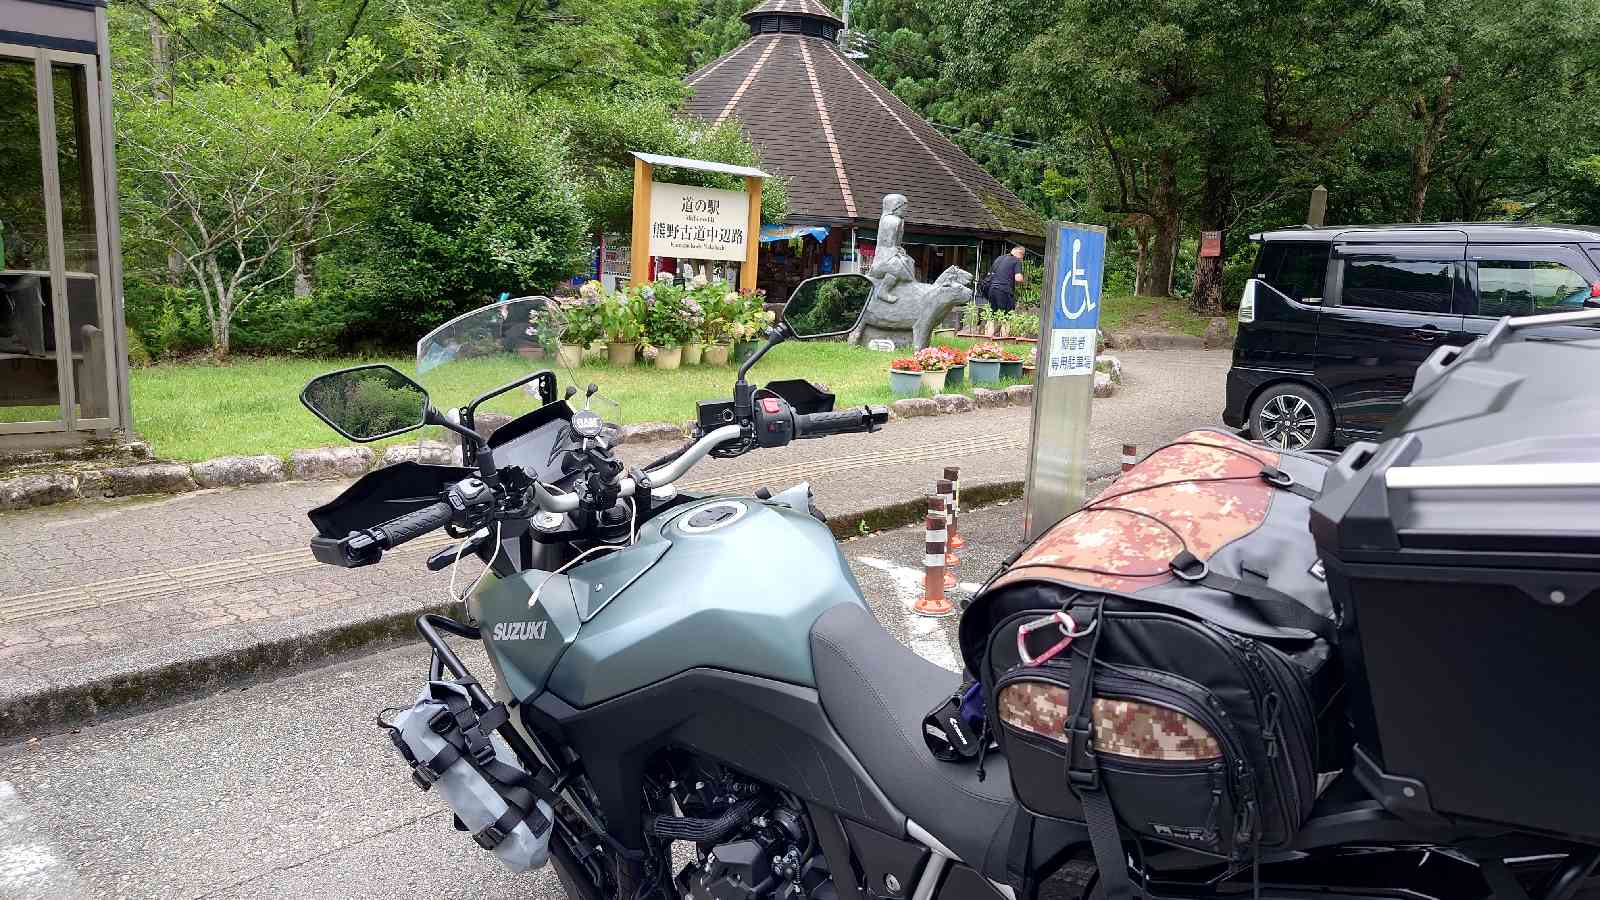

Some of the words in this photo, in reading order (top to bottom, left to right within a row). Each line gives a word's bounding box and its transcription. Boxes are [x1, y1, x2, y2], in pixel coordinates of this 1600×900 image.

[681, 196, 720, 215] 道の駅
[652, 221, 744, 245] 熊野古道中辺路
[493, 621, 548, 641] SUZUKI
